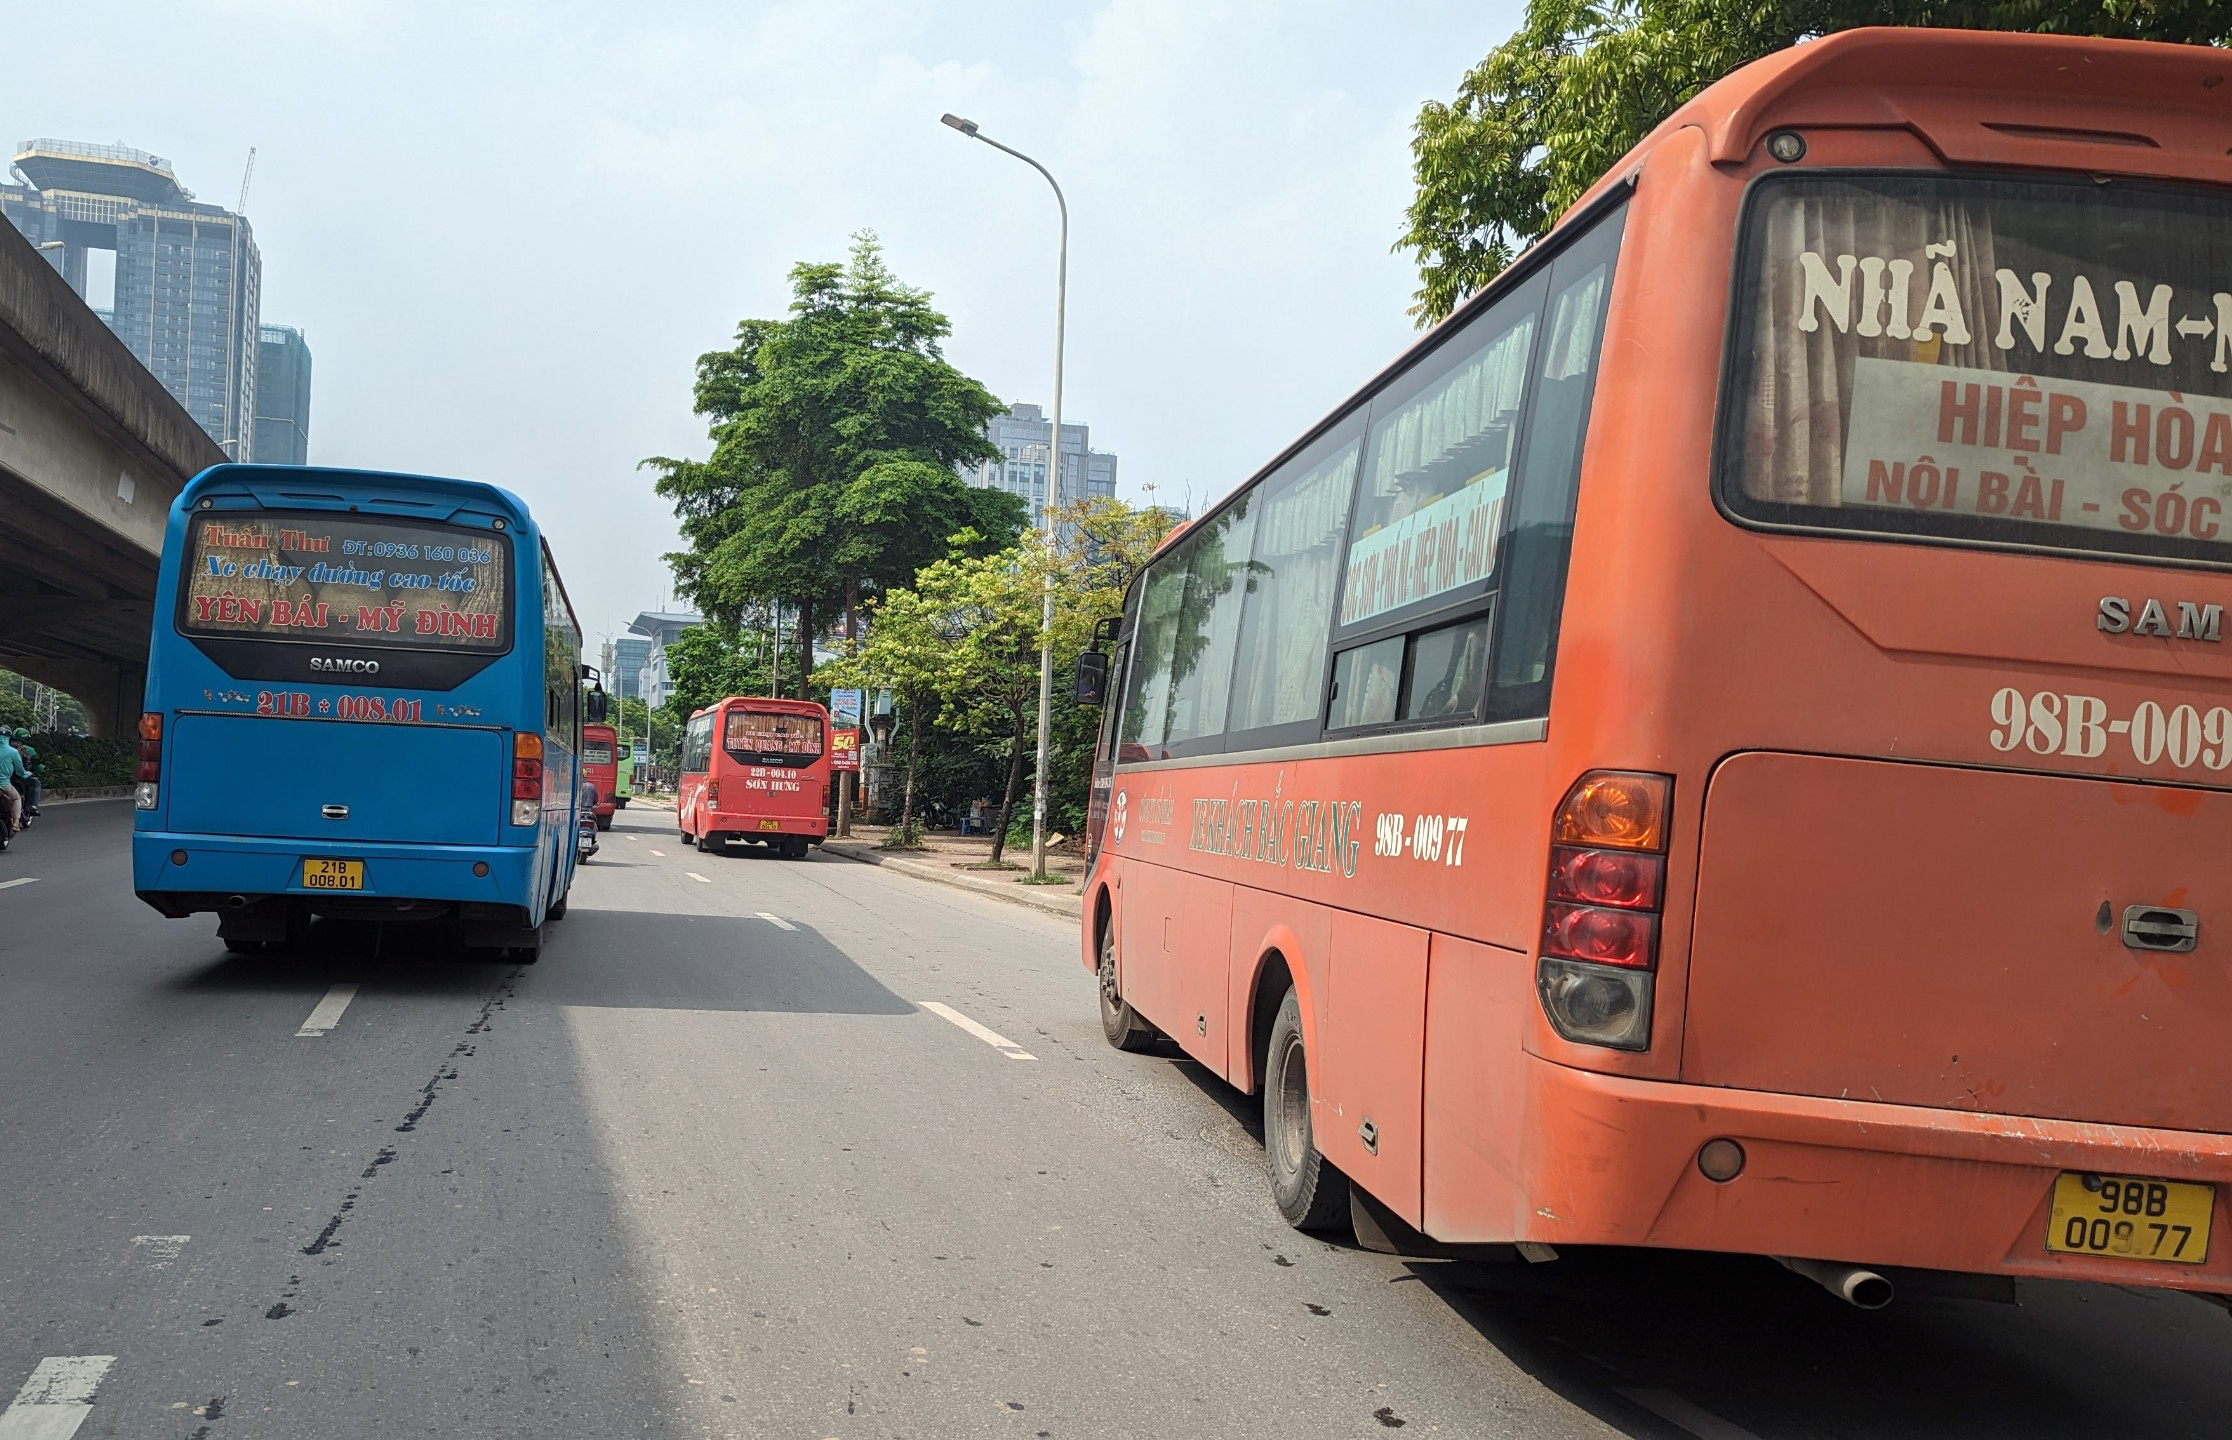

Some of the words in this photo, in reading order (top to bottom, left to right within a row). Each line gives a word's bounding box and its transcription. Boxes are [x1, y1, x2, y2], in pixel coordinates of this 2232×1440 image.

[1798, 239, 1971, 346] NHÃ
[1994, 268, 2173, 366] NAM
[1937, 376, 2088, 467] HIỆP
[2110, 391, 2232, 476] HÒA
[1975, 465, 2064, 521] BÀI
[2118, 482, 2222, 539] SÓC
[206, 524, 270, 549] Tuấn
[280, 528, 331, 552] Thư
[424, 546, 454, 561] 160
[458, 549, 491, 564] 036
[203, 555, 237, 577] Xe
[243, 559, 305, 586] chạy
[388, 572, 432, 589] cao
[438, 567, 477, 593] tốc
[195, 590, 262, 624] YÊN
[271, 594, 330, 628] BÁI
[356, 600, 406, 632] MỸ
[415, 604, 497, 639] ĐÌNH
[2097, 596, 2232, 641] SAM
[309, 657, 380, 674] SAMCO
[257, 690, 311, 717] 21B
[336, 694, 423, 723] 008.01
[1205, 780, 1258, 861] KHÁCH
[1255, 770, 1294, 867] BẮC
[1294, 800, 1362, 879] GIANG
[309, 874, 355, 888] 008.01
[321, 861, 347, 874] 21B
[2099, 1180, 2168, 1217] 98B
